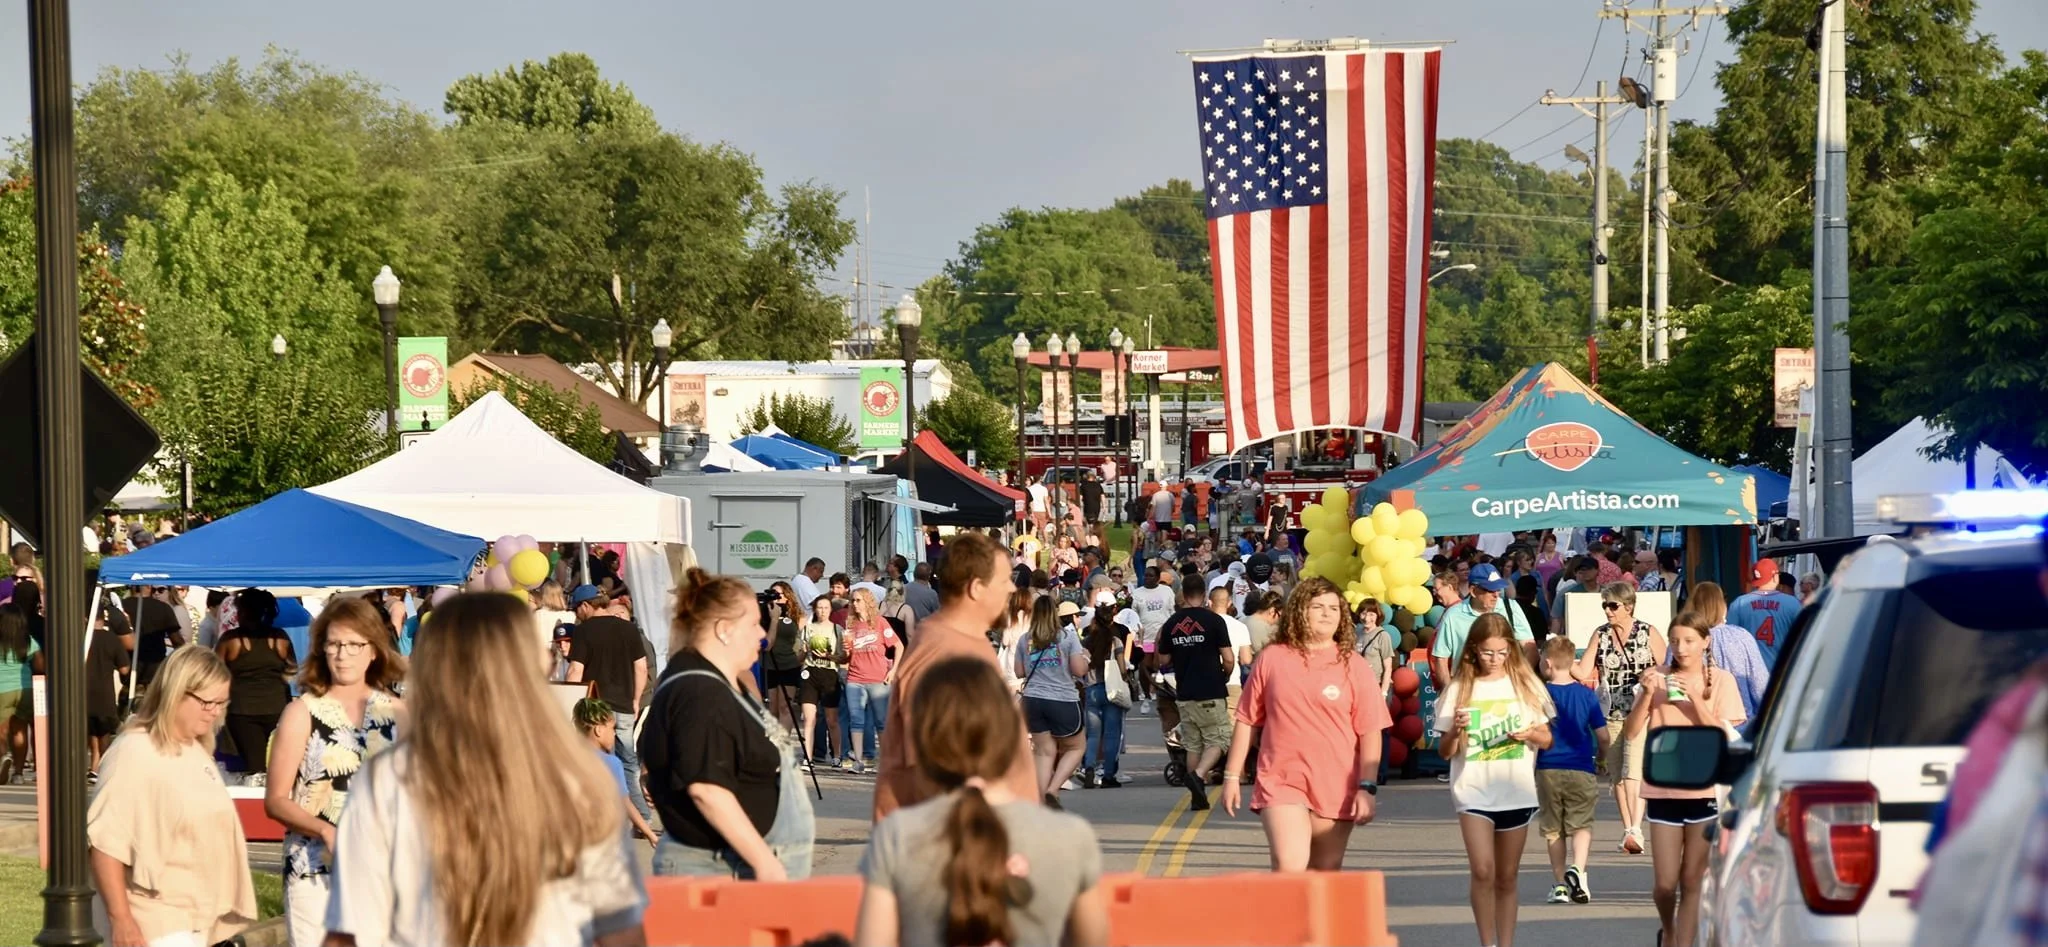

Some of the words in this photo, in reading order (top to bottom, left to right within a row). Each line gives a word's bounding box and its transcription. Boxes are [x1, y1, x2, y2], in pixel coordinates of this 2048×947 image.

[1133, 353, 1163, 362] Korner
[1133, 363, 1166, 371] Market
[403, 405, 446, 413] FARMERS
[863, 428, 899, 436] MARKET
[1535, 429, 1589, 441] CARPE
[1497, 437, 1617, 467] Artista
[1471, 489, 1680, 518] CarpeArtista.com
[1755, 615, 1775, 647] 4
[1171, 635, 1205, 645] ELEVATED
[1467, 712, 1522, 751] Sprite
